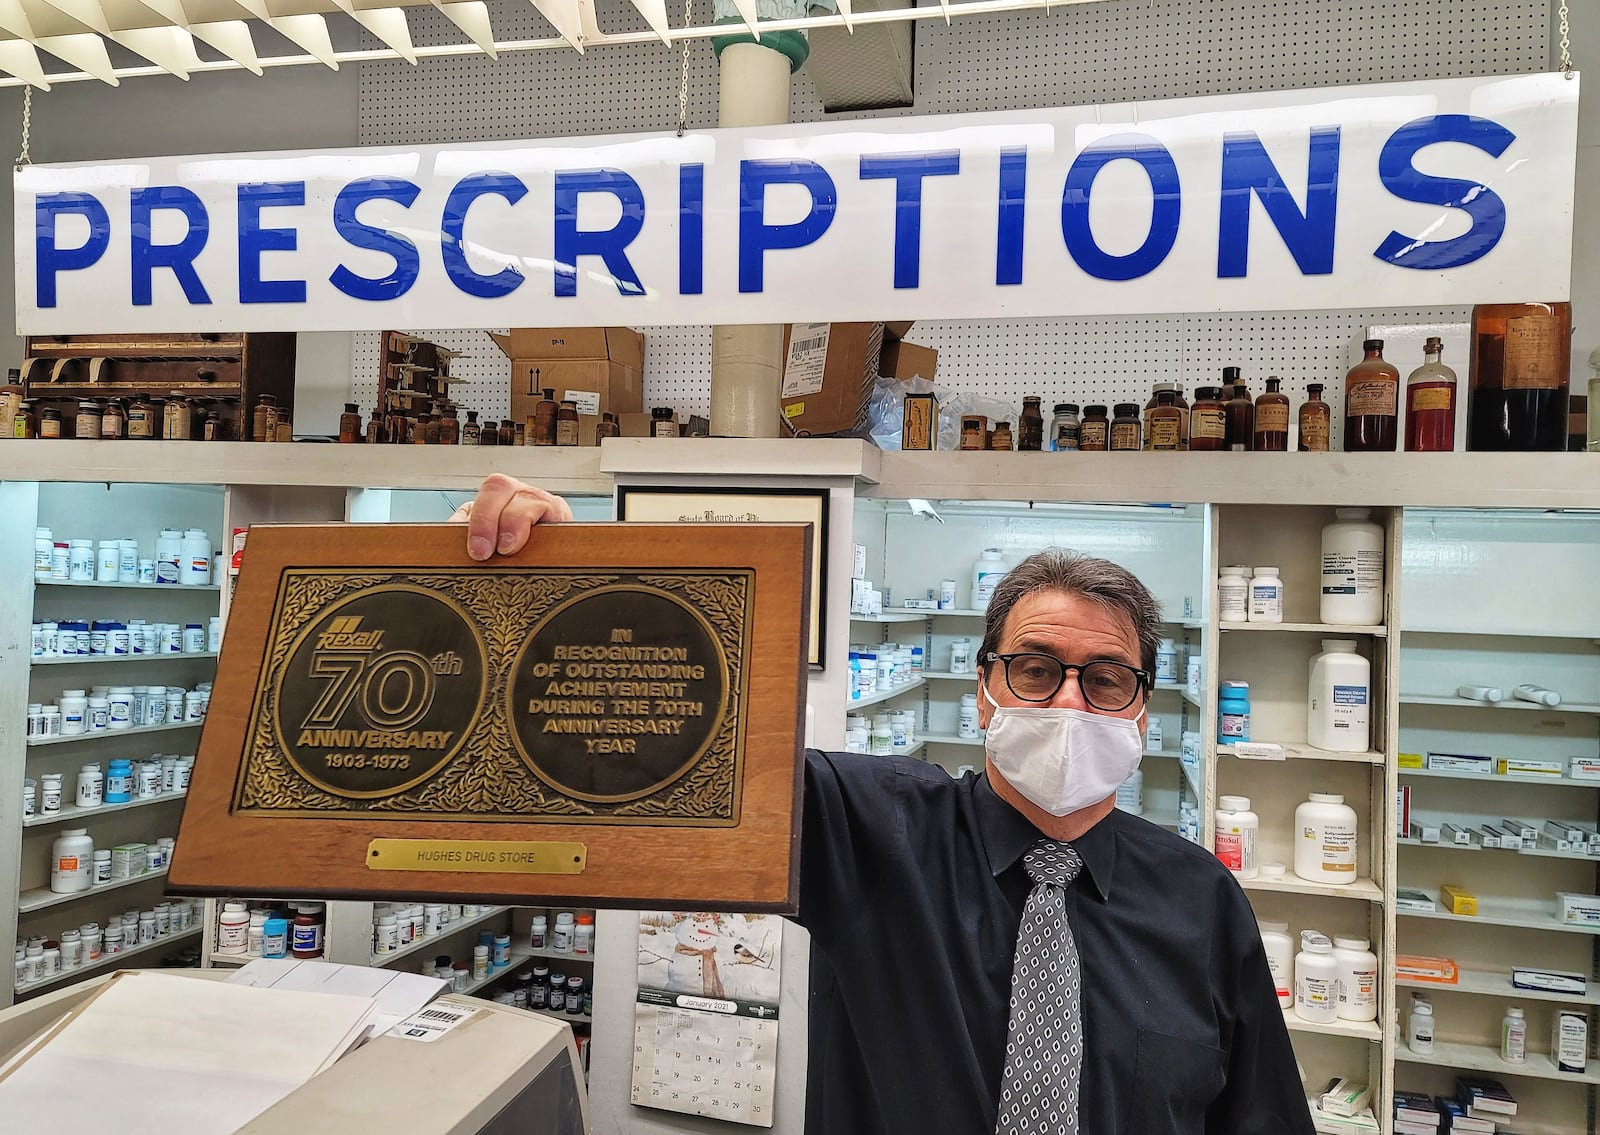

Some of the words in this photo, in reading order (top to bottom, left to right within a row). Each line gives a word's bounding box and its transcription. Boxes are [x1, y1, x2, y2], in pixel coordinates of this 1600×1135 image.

[36, 114, 1516, 307] PRESCRIPTIONS
[316, 630, 384, 650] Rexall
[610, 628, 633, 643] IN
[553, 645, 688, 662] RECOGNITION
[532, 663, 561, 678] OF
[566, 663, 705, 680] OUTSTANDING
[545, 681, 688, 697] ACHIEVEMENT
[529, 699, 605, 715] DURING
[611, 701, 650, 715] THE
[654, 701, 703, 716] 70TH
[542, 719, 685, 735] ANNIVERSARY
[297, 729, 453, 749] ANNIVERSARY
[585, 739, 636, 754] YEAR
[325, 753, 411, 769] 1903-1973
[417, 851, 462, 862] HUGHES
[465, 851, 495, 862] DRUG
[499, 852, 535, 863] STORE
[686, 998, 713, 1009] January
[714, 1001, 729, 1010] 2021
